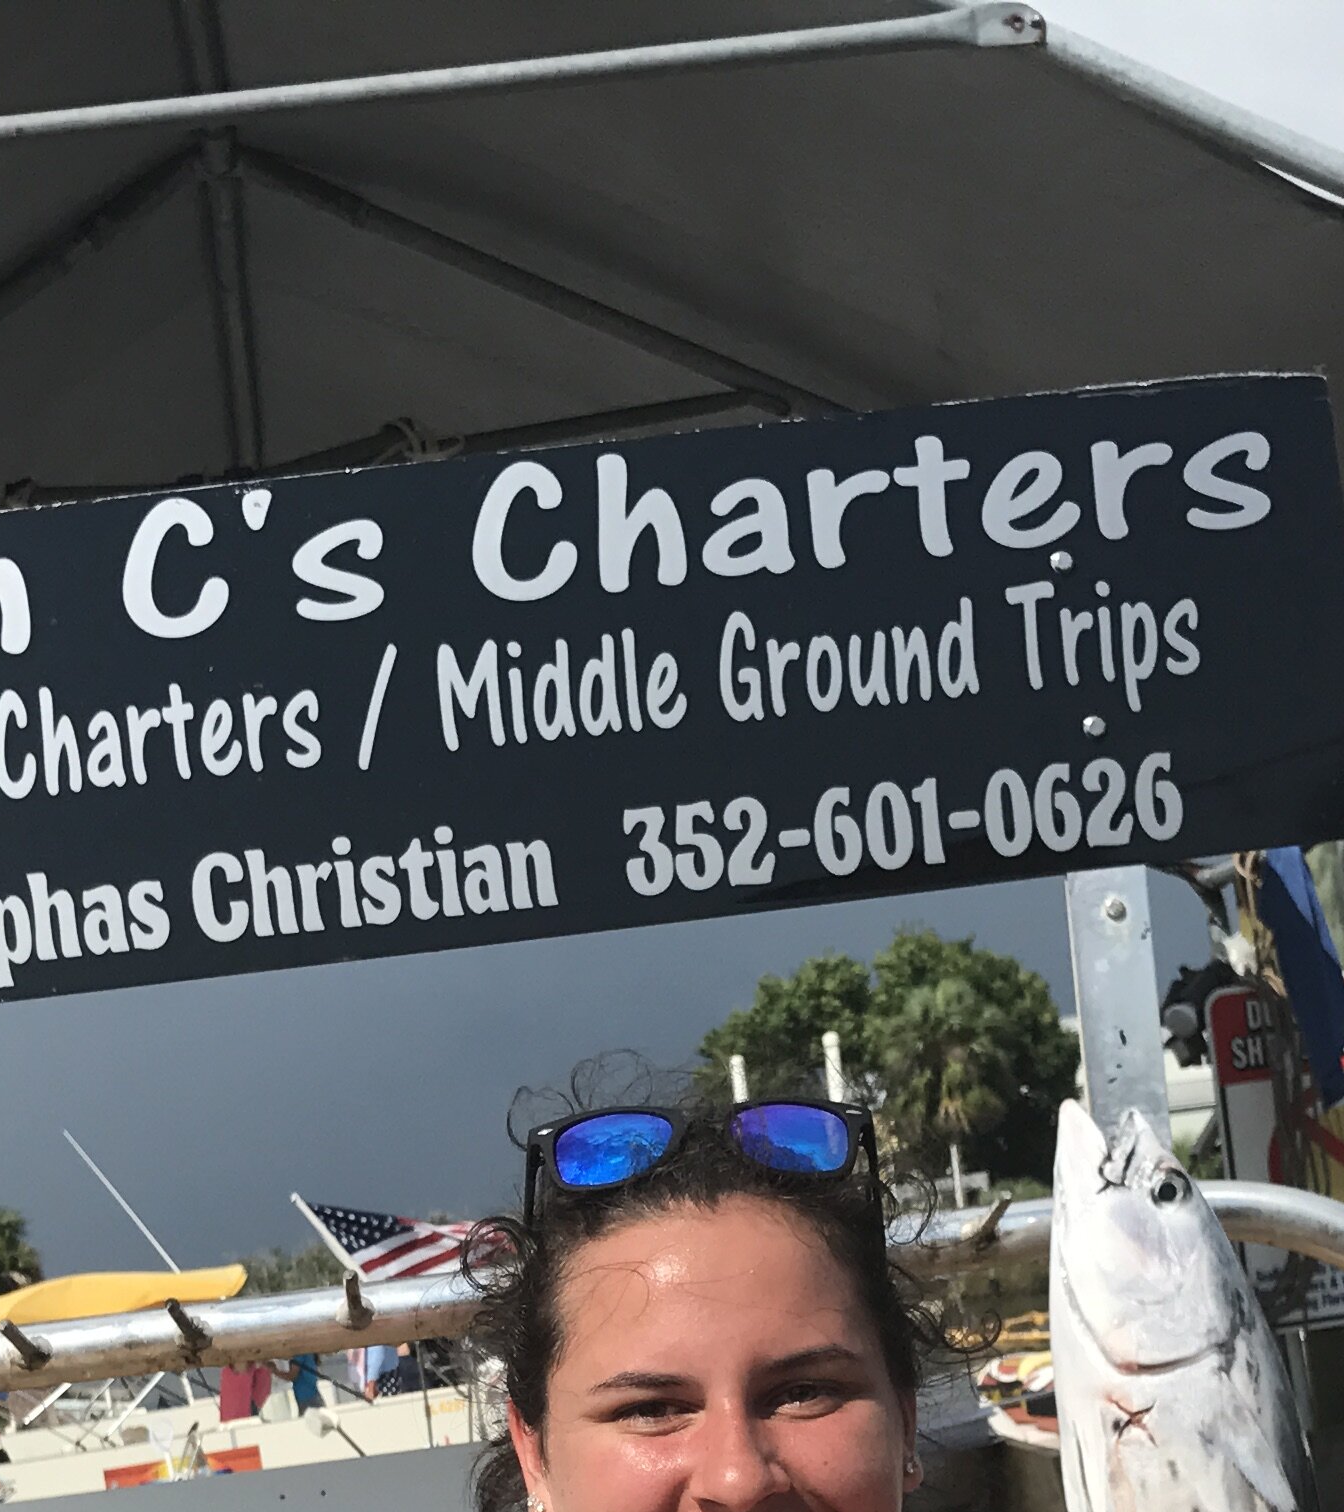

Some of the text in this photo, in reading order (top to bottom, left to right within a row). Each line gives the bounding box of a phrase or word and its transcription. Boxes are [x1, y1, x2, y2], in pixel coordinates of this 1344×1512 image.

[122, 488, 386, 639] C's
[472, 430, 1272, 602] Charters
[358, 643, 398, 772] /
[436, 628, 689, 752] Middle
[718, 597, 981, 723] Ground
[1004, 580, 1202, 712] Trips
[191, 836, 560, 942] Christian
[622, 751, 1185, 898] 352-601-0626
